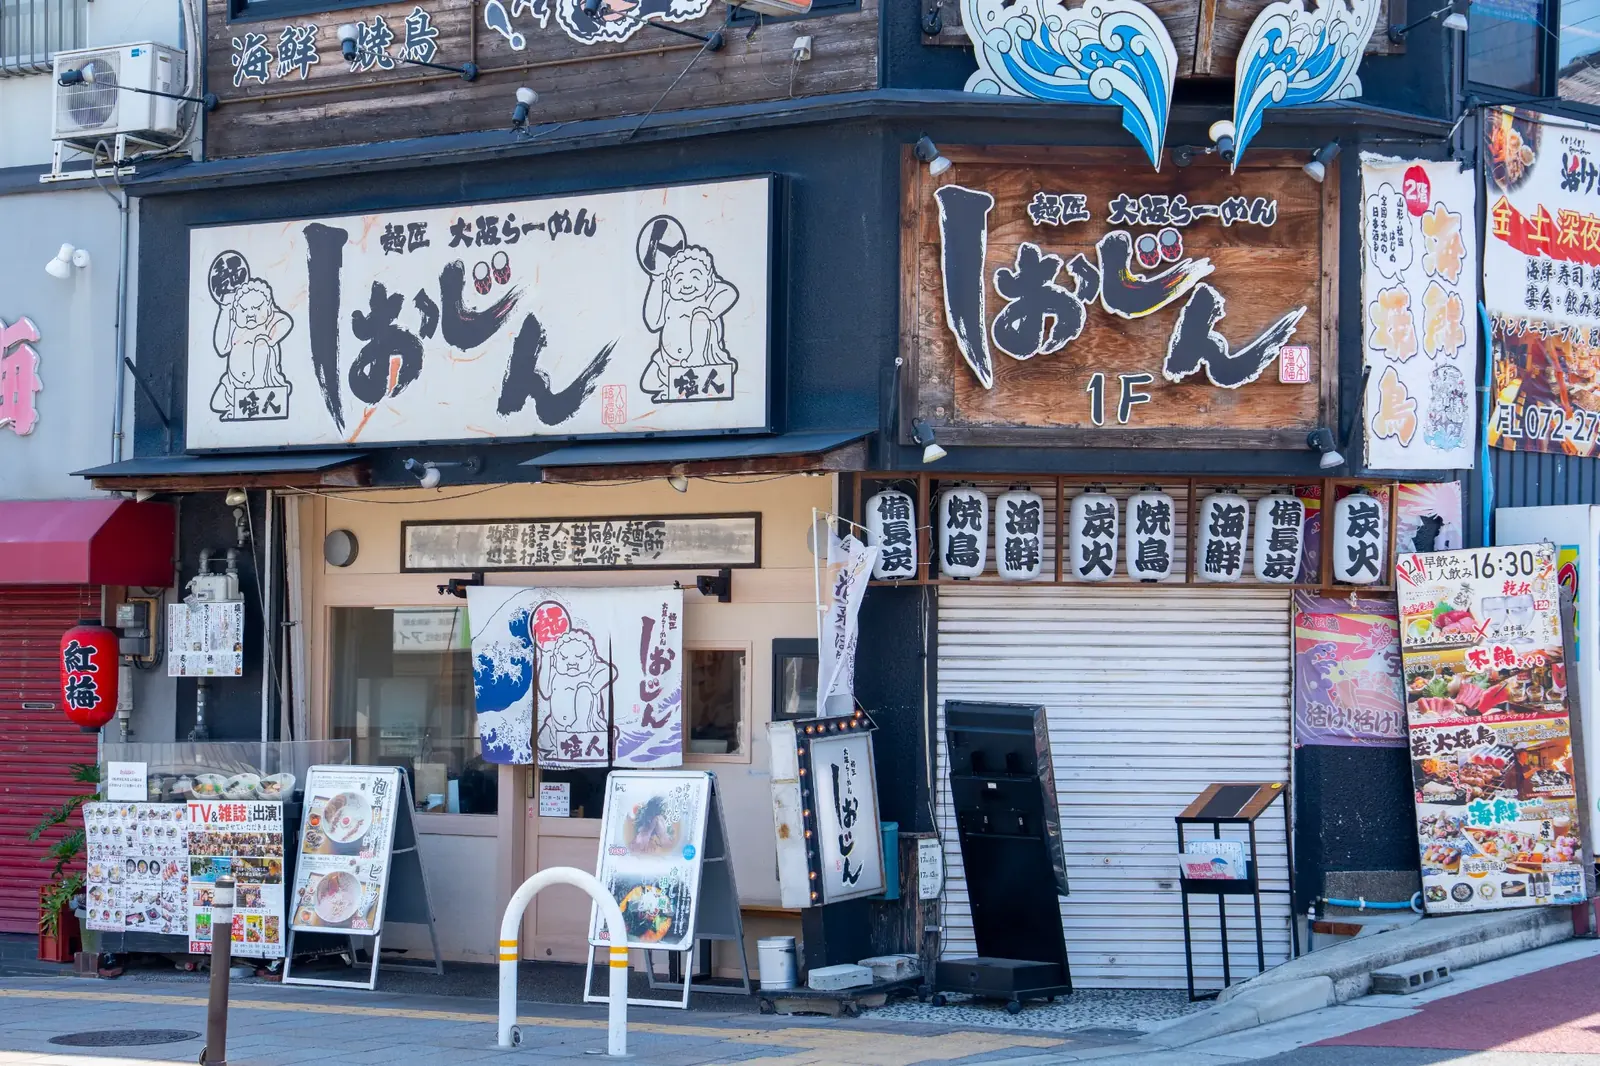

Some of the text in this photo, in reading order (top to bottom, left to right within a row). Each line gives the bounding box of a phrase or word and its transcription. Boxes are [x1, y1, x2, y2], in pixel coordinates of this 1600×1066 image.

[231, 24, 320, 87] 海鮮
[350, 6, 440, 72] 焼鳥
[1027, 192, 1277, 226] 麺匠 大阪らーめん
[1404, 179, 1428, 204] 2階
[1560, 152, 1600, 195] 活け
[380, 207, 597, 256] 麺匠 大阪らーめん
[934, 185, 1307, 389] しおじん
[303, 222, 621, 437] しおじん
[239, 390, 281, 418] 塩人
[674, 368, 725, 399] 塩人
[1086, 372, 1154, 427] 1F
[877, 495, 913, 572] 備長炭
[946, 495, 983, 568] 焼鳥
[1005, 499, 1041, 572] 海鮮
[1079, 501, 1116, 577] 炭火
[1135, 499, 1171, 573] 焼鳥
[1204, 502, 1246, 576] 海鮮
[1263, 500, 1301, 579] 備長炭
[1346, 501, 1381, 578] 炭火
[1470, 550, 1534, 580] 16:30
[63, 639, 101, 710] 紅梅
[639, 615, 677, 729] しおじん
[1411, 724, 1496, 757] 炭火焼鳥
[831, 763, 865, 888] しおじん
[1469, 799, 1520, 826] 海鮮
